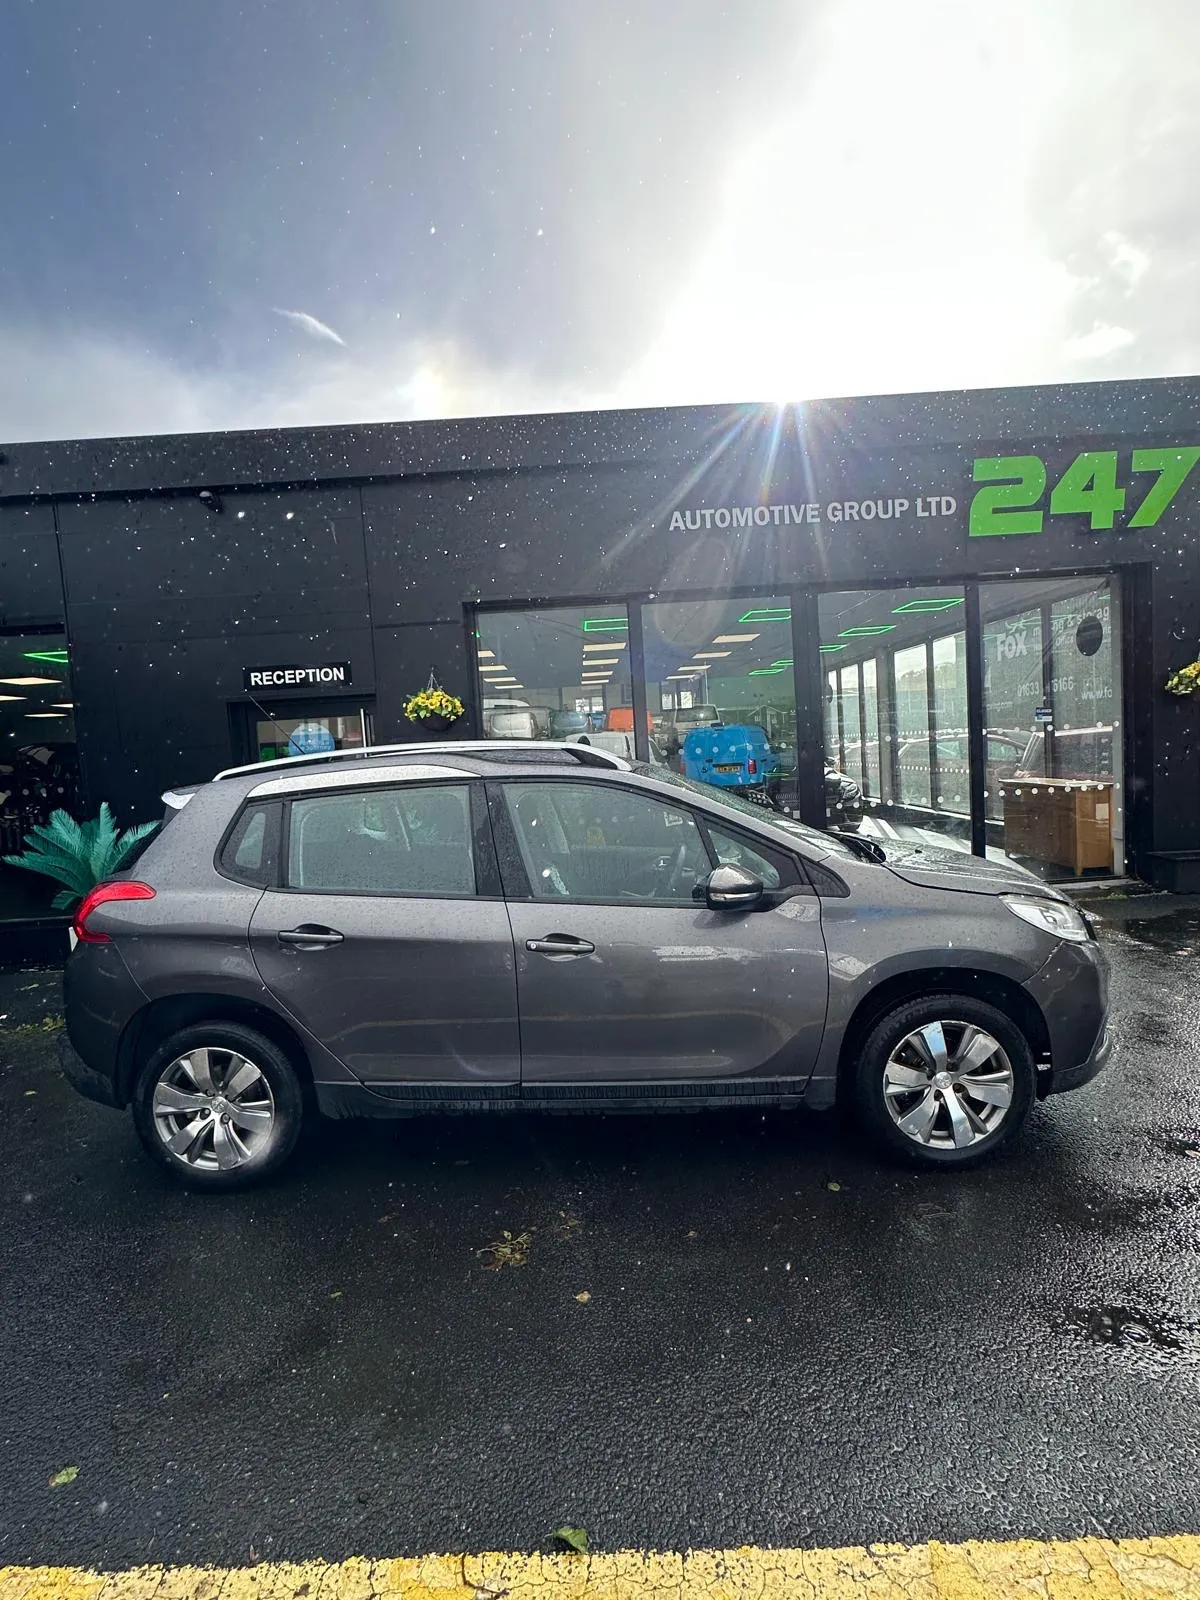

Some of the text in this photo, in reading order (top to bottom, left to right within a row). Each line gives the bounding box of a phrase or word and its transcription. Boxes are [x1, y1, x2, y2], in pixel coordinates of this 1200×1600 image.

[968, 446, 1200, 537] 247
[668, 496, 957, 532] AUTOMOTIVE GROUP LTD
[996, 630, 1028, 661] FOX
[250, 667, 345, 686] RECEPTION
